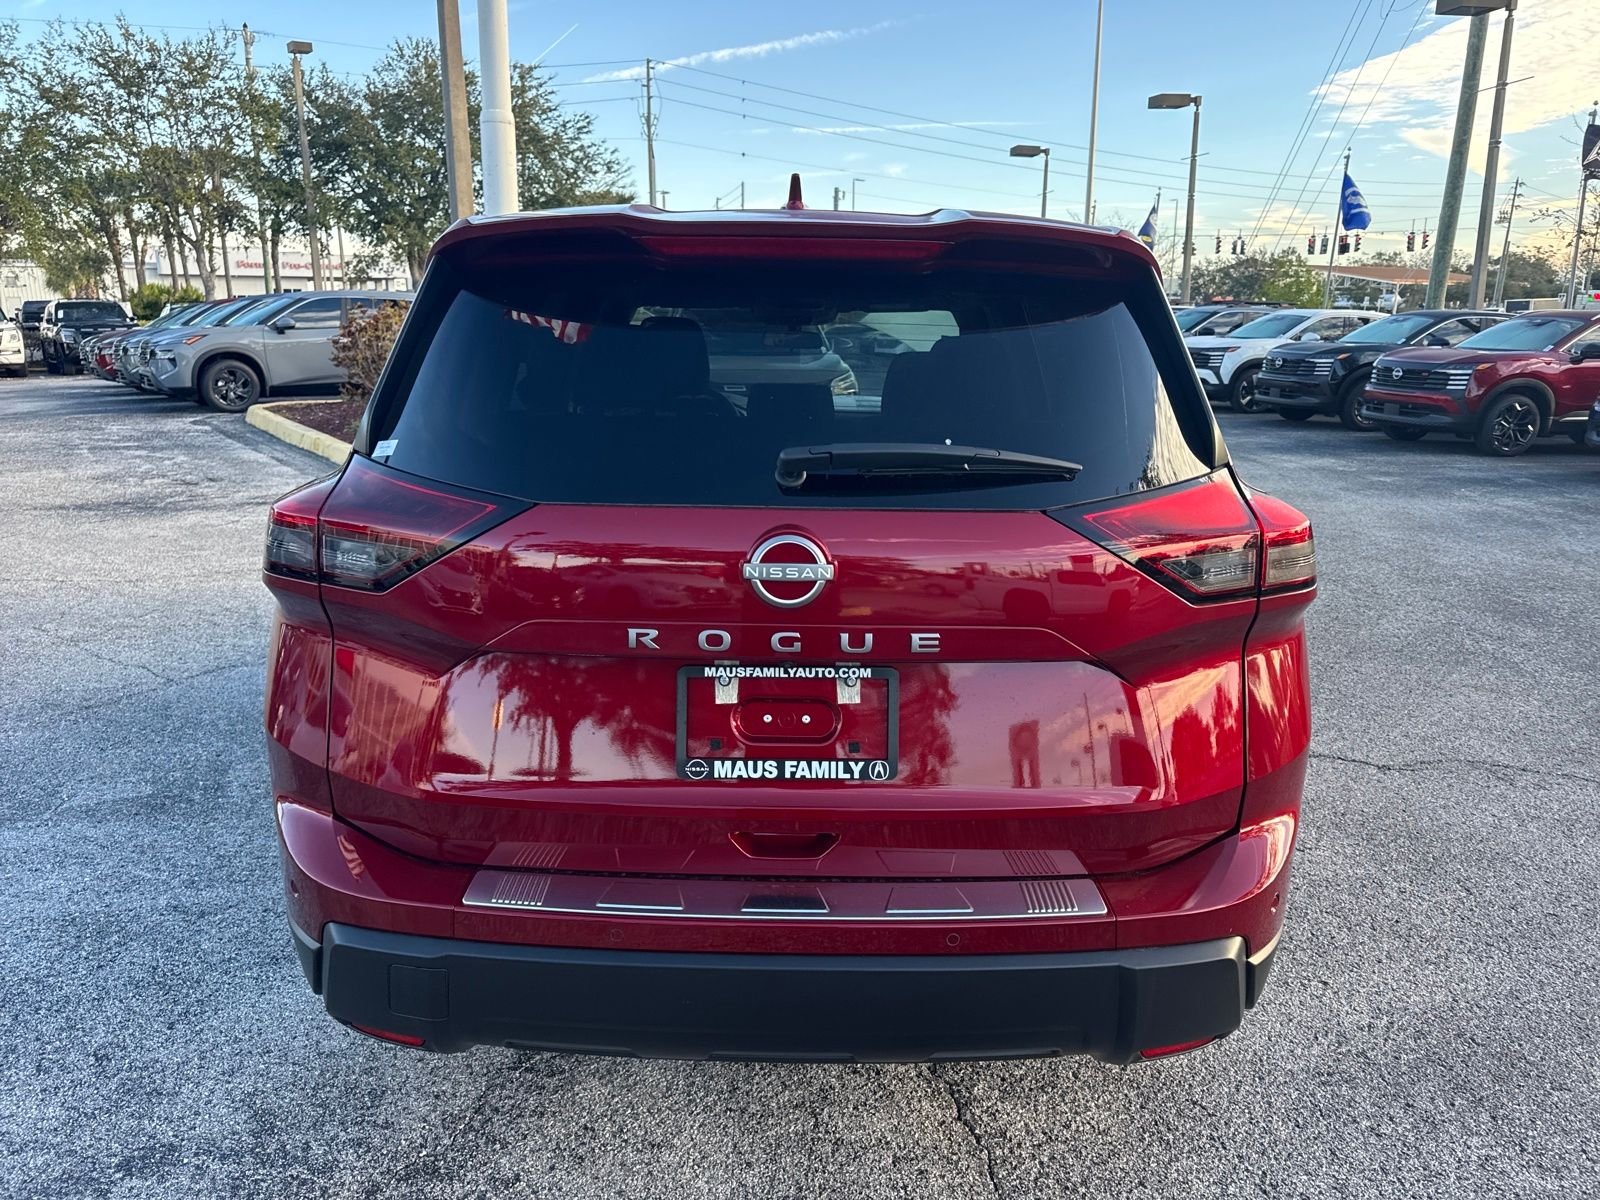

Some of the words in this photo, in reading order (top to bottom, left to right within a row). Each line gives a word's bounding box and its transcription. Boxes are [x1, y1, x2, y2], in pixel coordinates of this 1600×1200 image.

[745, 566, 832, 579] NISSAN
[627, 628, 941, 653] ROGUE
[704, 667, 872, 678] MAUSFAMILYAUTO.COM
[713, 760, 778, 778] MAUS
[784, 761, 865, 779] FAMILY
